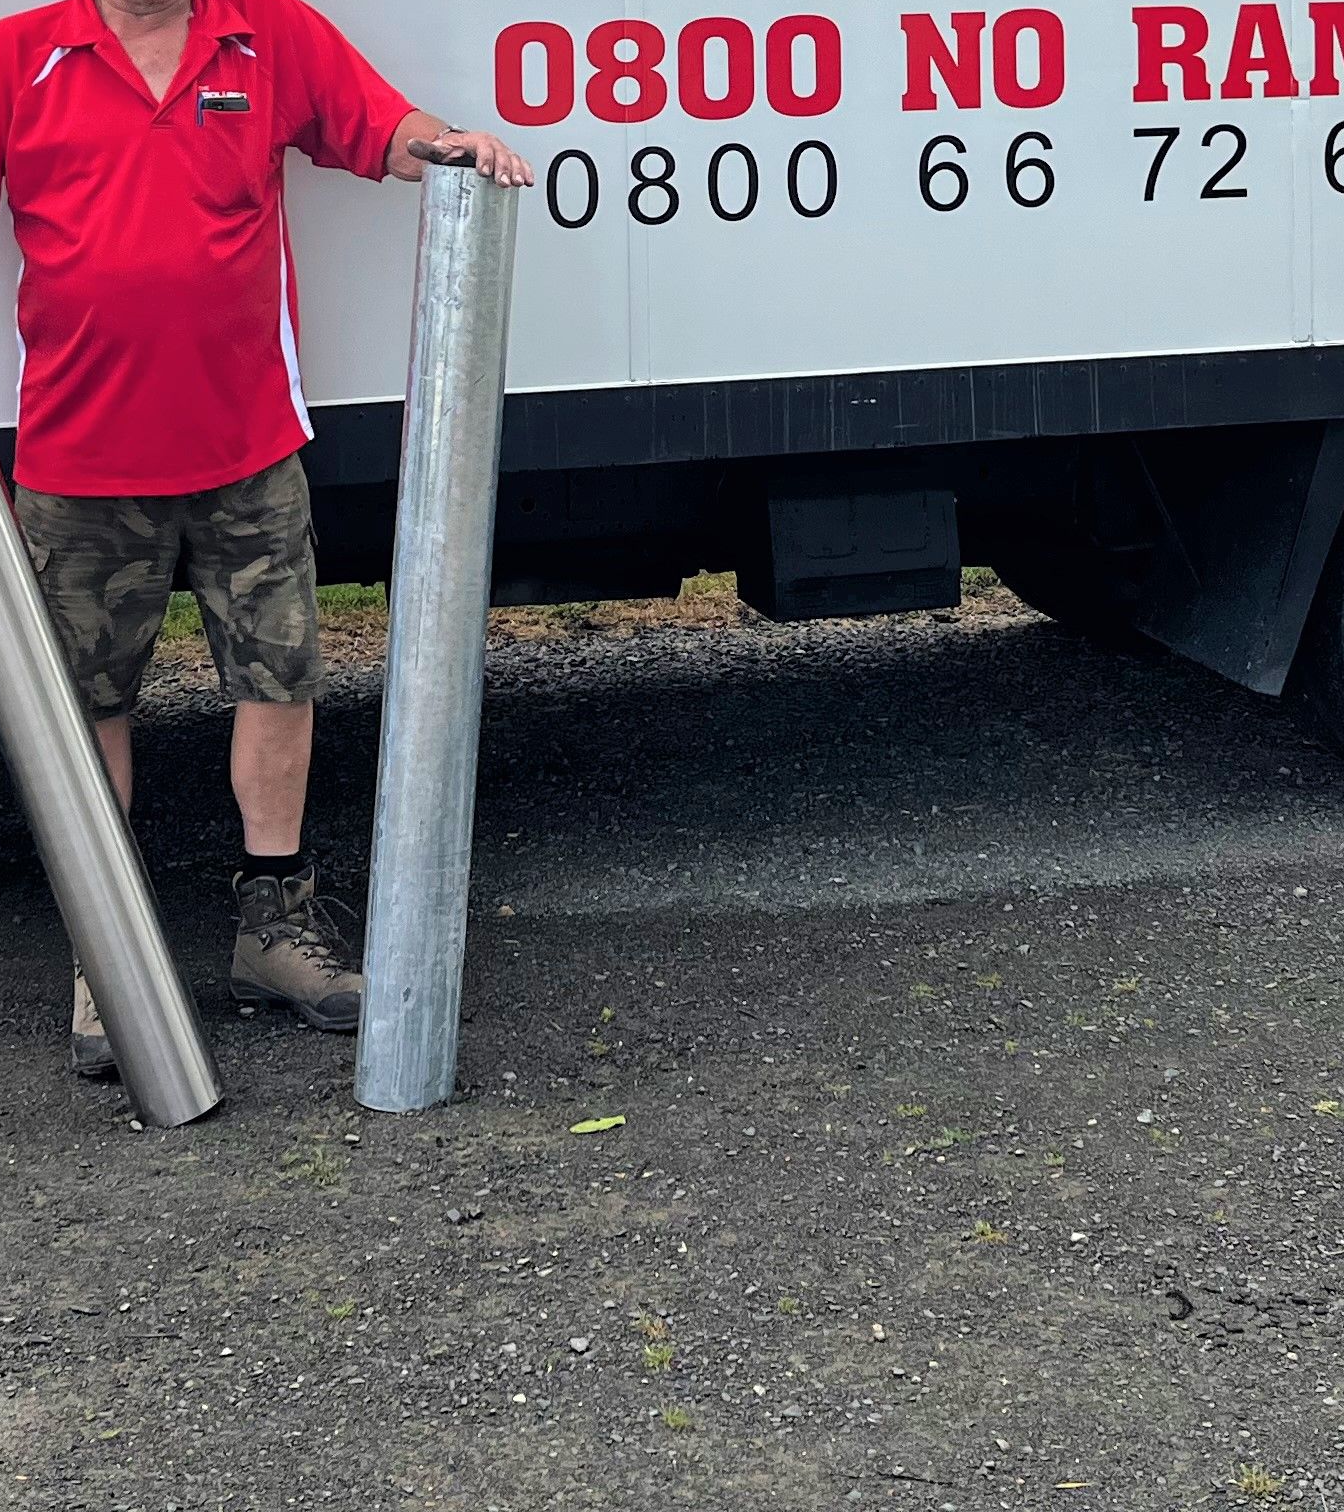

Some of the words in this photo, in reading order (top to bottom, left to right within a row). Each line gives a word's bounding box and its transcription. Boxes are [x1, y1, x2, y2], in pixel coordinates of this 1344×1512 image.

[495, 15, 841, 126] 0800
[901, 9, 1065, 111] NO
[547, 140, 837, 228] 0800
[919, 132, 1054, 211] 66
[1134, 124, 1247, 201] 72
